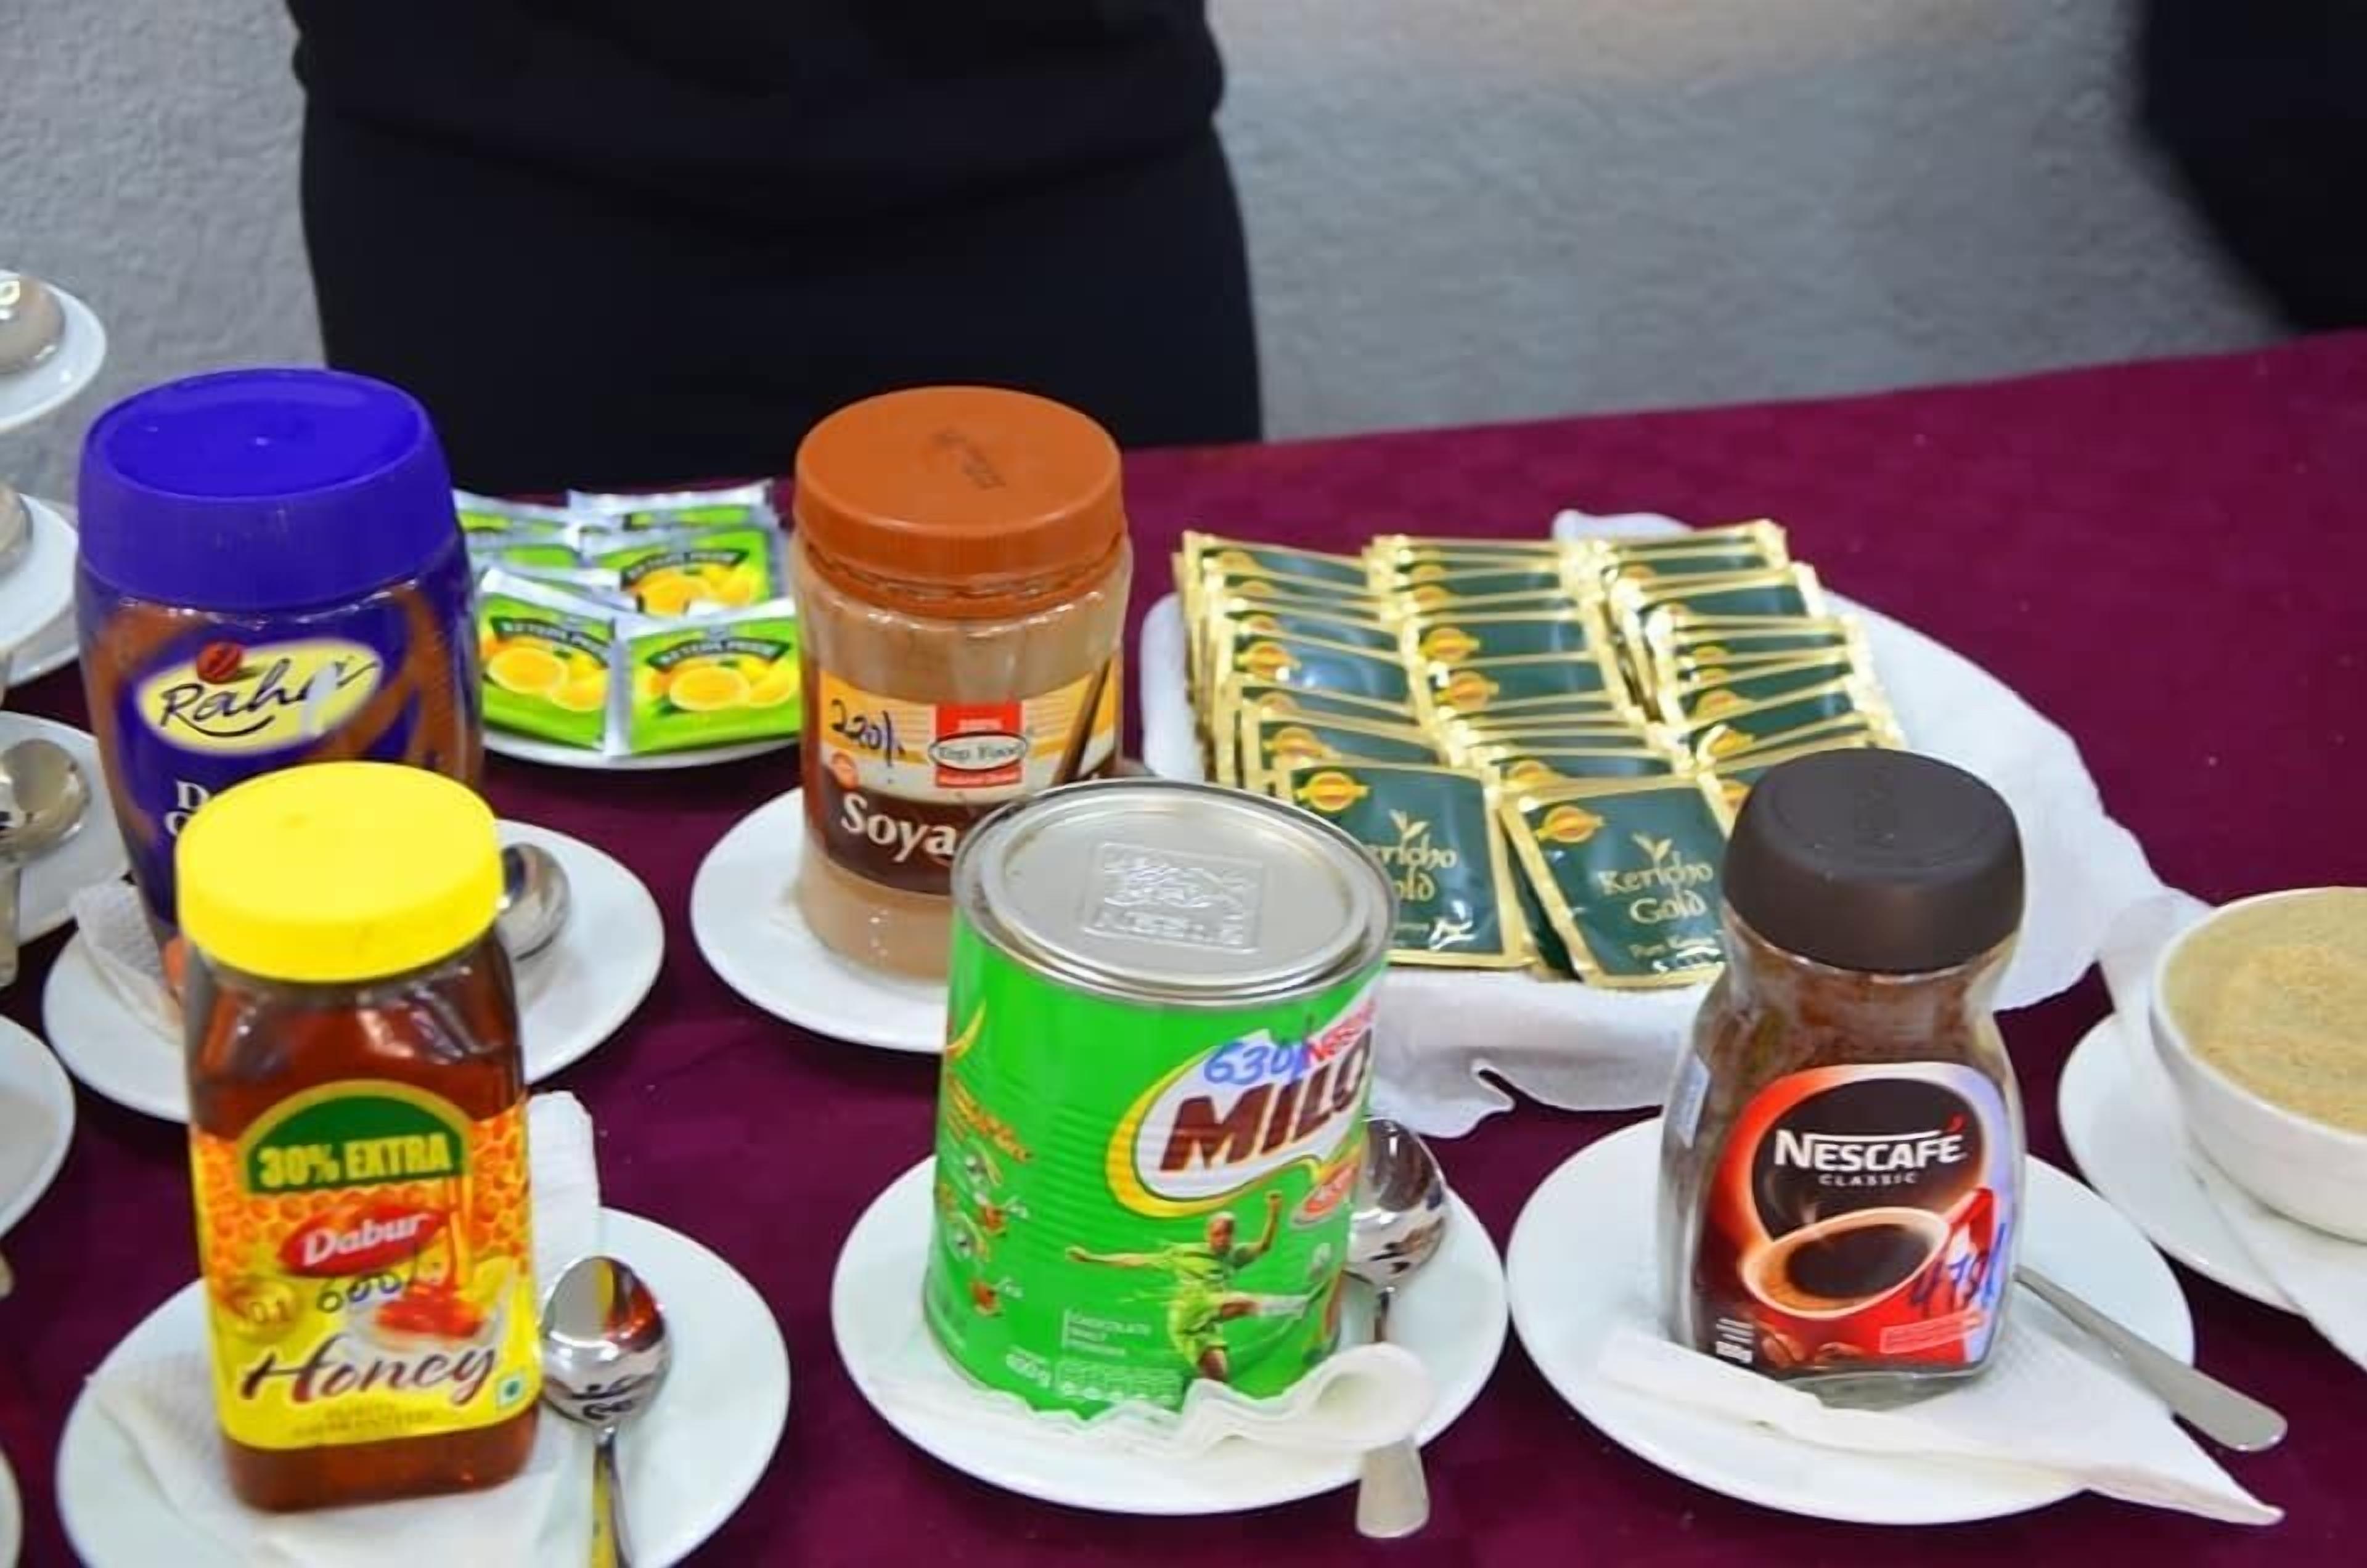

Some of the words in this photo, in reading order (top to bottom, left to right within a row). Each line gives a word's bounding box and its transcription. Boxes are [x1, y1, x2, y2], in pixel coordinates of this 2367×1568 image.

[841, 793, 957, 862] Soya
[1362, 832, 1457, 872] ericho
[1597, 851, 1714, 895] Kericho
[1630, 889, 1707, 925] Gold
[1159, 1028, 1370, 1172] MILO
[259, 1143, 340, 1188] 30%
[345, 1133, 453, 1180] EXTRA
[1818, 1172, 1917, 1186] CLASSIC
[304, 1213, 435, 1267] Dabur
[240, 1330, 494, 1405] Honey
